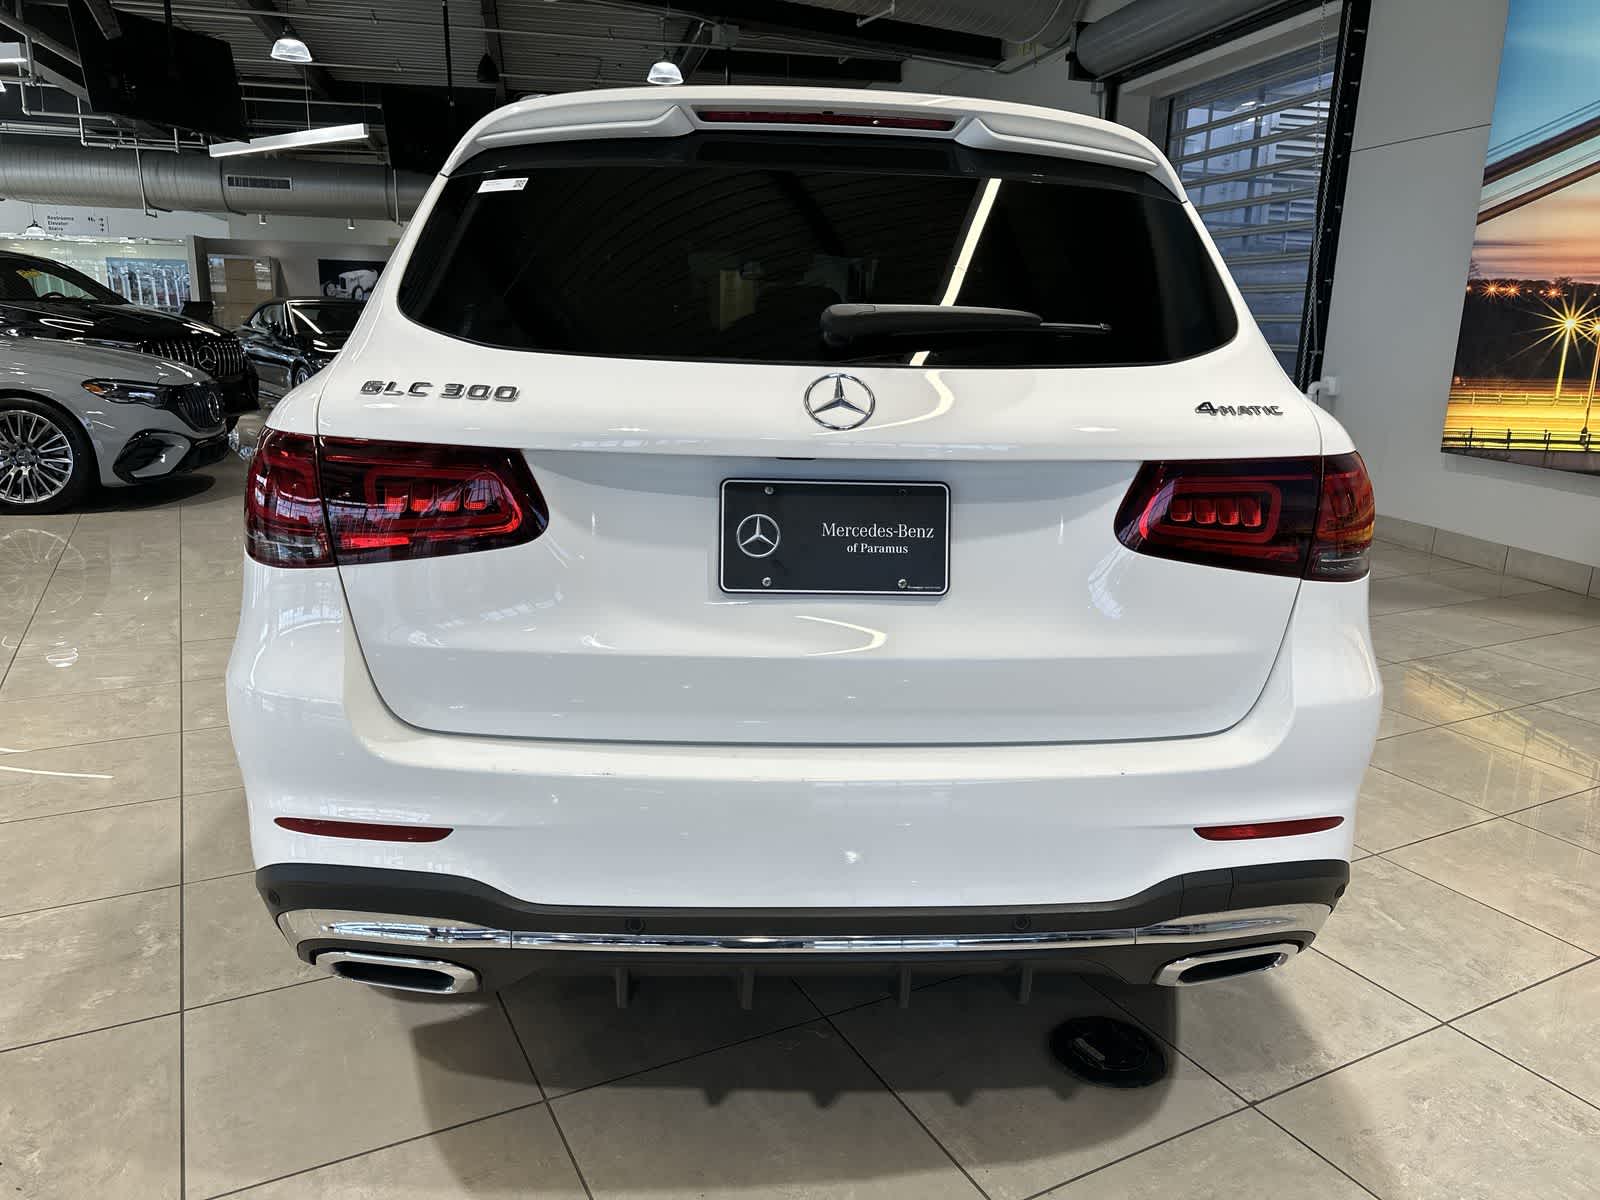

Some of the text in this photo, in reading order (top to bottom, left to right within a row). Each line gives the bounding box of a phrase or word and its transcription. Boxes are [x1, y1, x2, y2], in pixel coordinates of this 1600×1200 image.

[360, 380, 521, 402] GLC 300
[1195, 401, 1284, 416] 4MATIC
[821, 522, 935, 539] Mercedes-Benz
[846, 542, 909, 554] of Paramus
